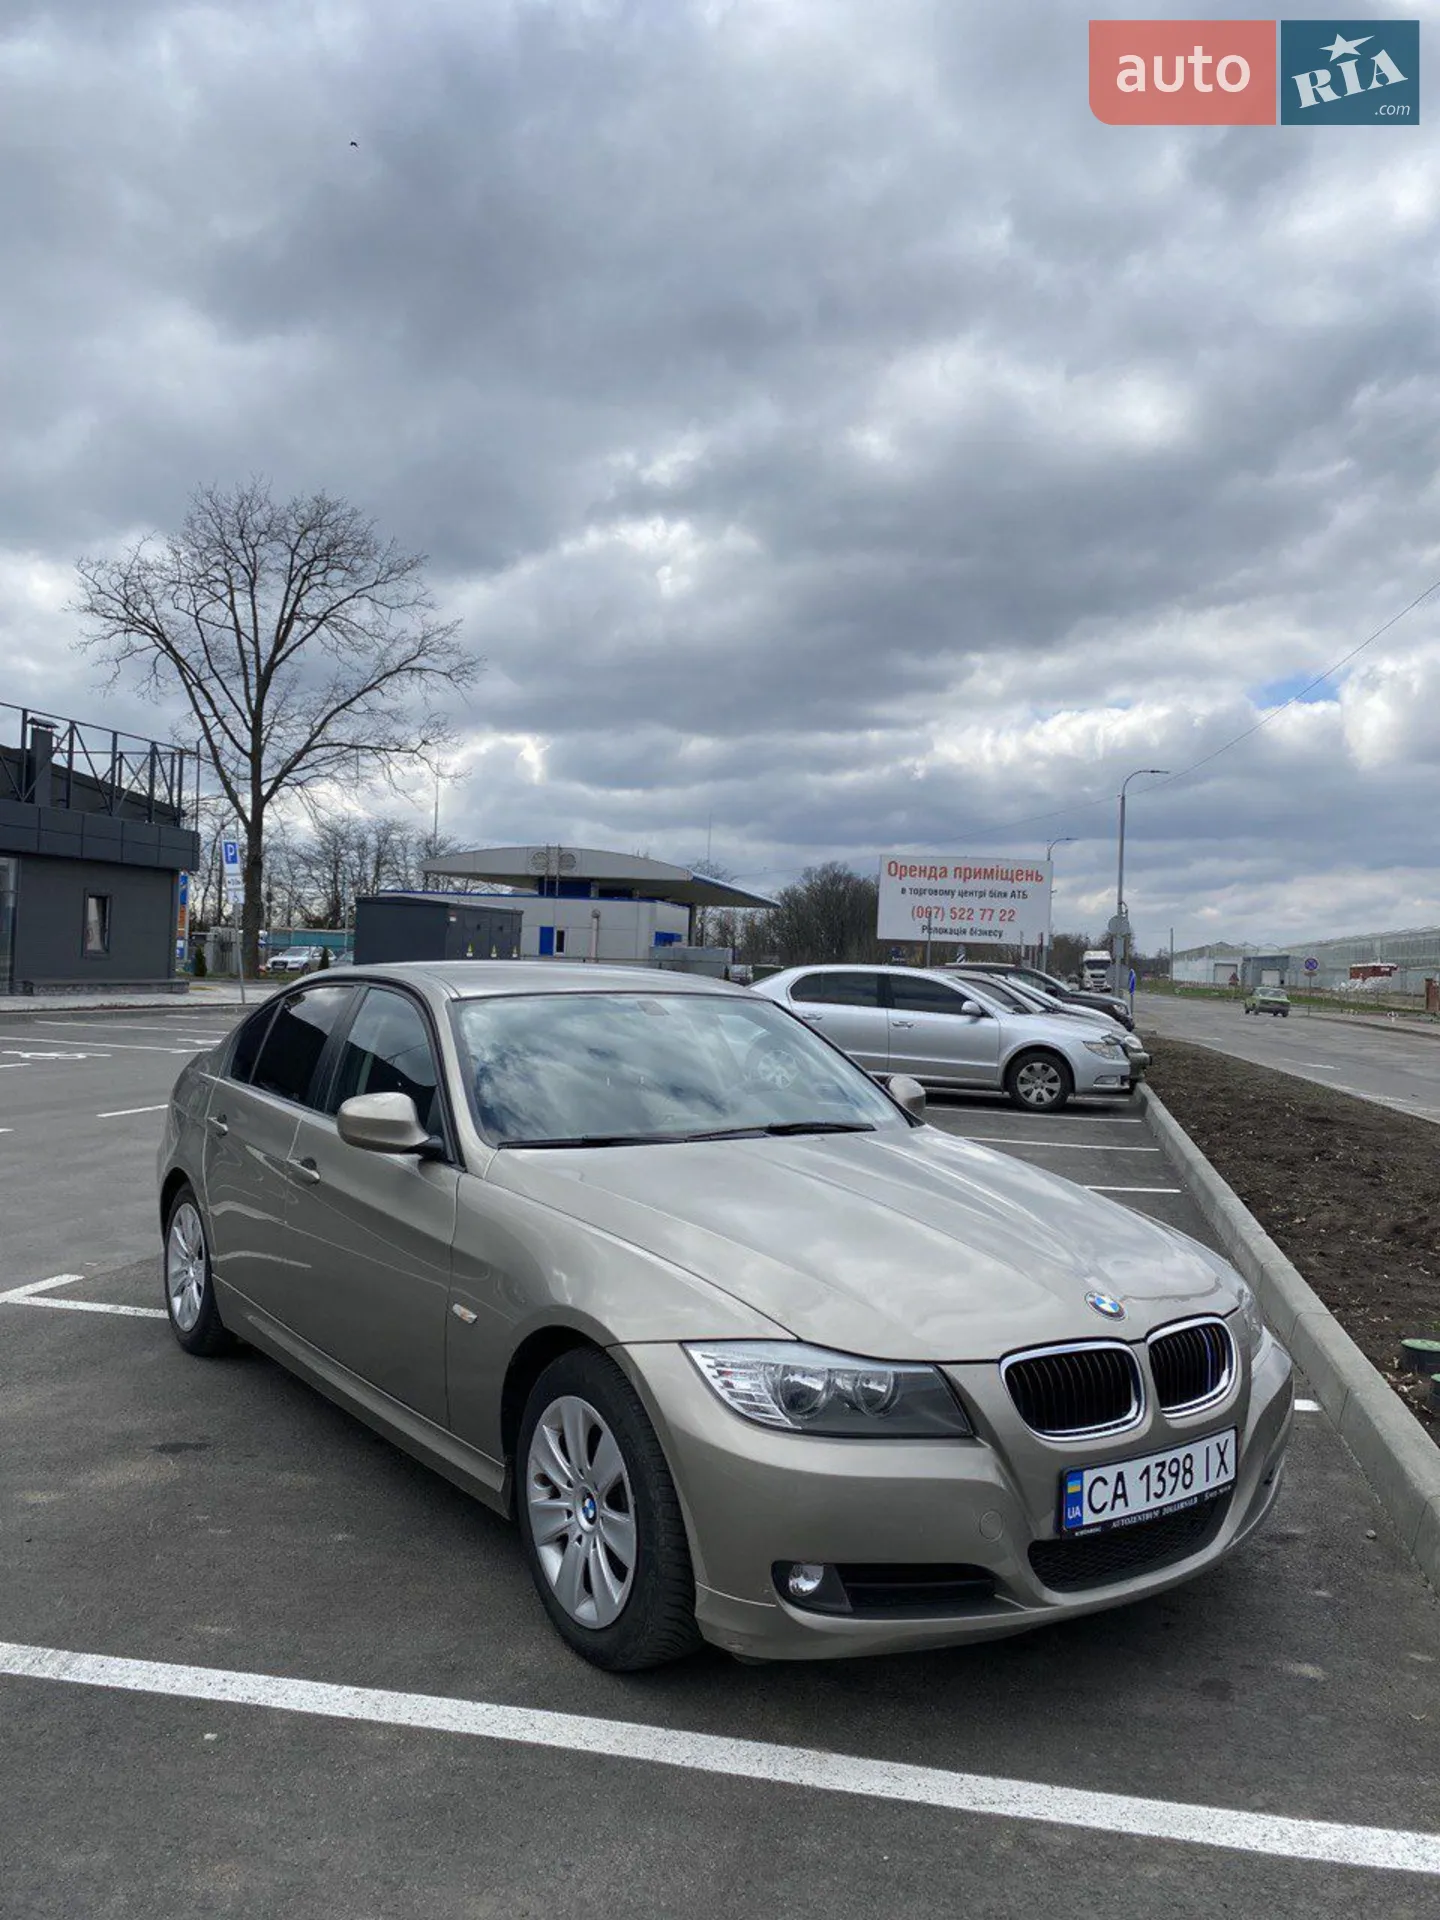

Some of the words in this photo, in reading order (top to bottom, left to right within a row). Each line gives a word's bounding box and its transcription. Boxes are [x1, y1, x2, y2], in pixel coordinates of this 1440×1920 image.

[888, 861, 948, 881] Оренда
[953, 865, 1044, 883] приміщень
[909, 888, 956, 899] торговому
[958, 889, 986, 899] центрі
[988, 889, 1008, 898] біля
[1010, 890, 1029, 899] АТБ
[950, 907, 974, 921] 522
[979, 908, 994, 921] 77
[999, 908, 1015, 921] 22
[969, 927, 1003, 939] бізнесу
[1088, 1471, 1129, 1515] CA
[1138, 1453, 1194, 1502] 1398
[1067, 1506, 1082, 1520] UA
